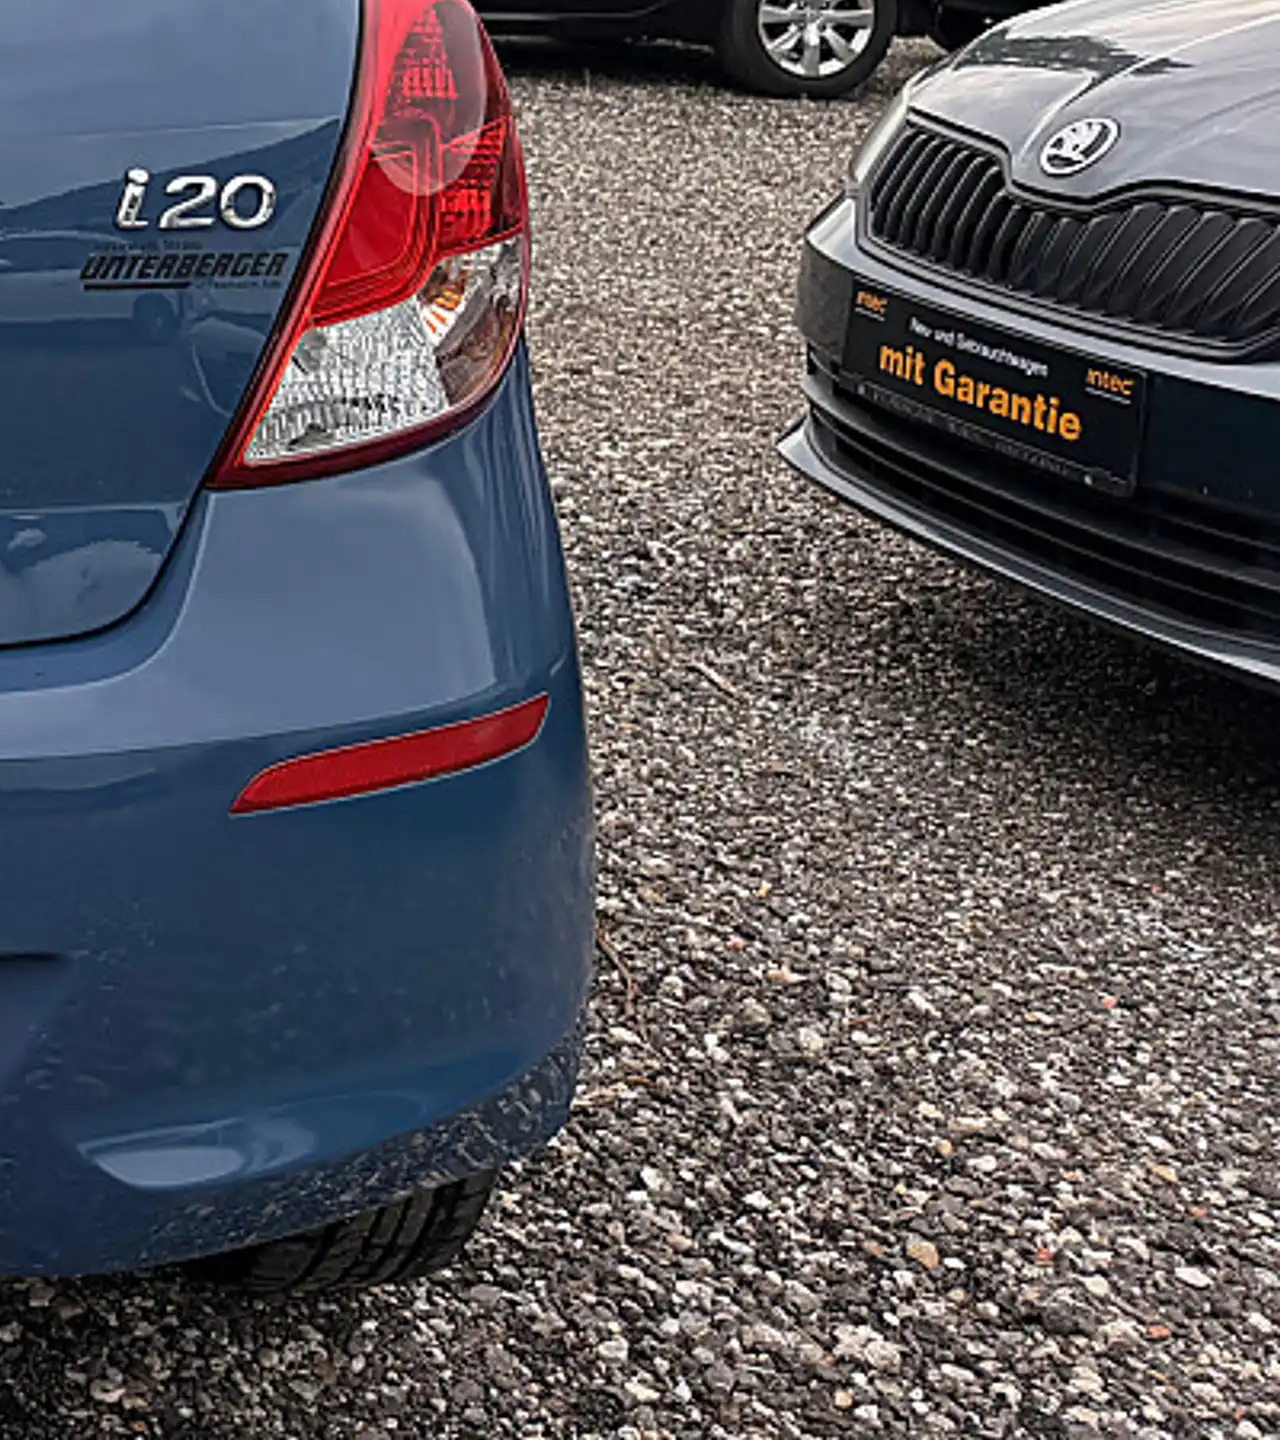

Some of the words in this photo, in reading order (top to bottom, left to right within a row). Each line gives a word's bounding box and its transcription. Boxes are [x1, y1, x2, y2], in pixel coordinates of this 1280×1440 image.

[115, 167, 277, 230] i20
[79, 251, 289, 281] UNTERBERGER
[878, 344, 927, 387] mit
[933, 359, 1084, 442] Garantie
